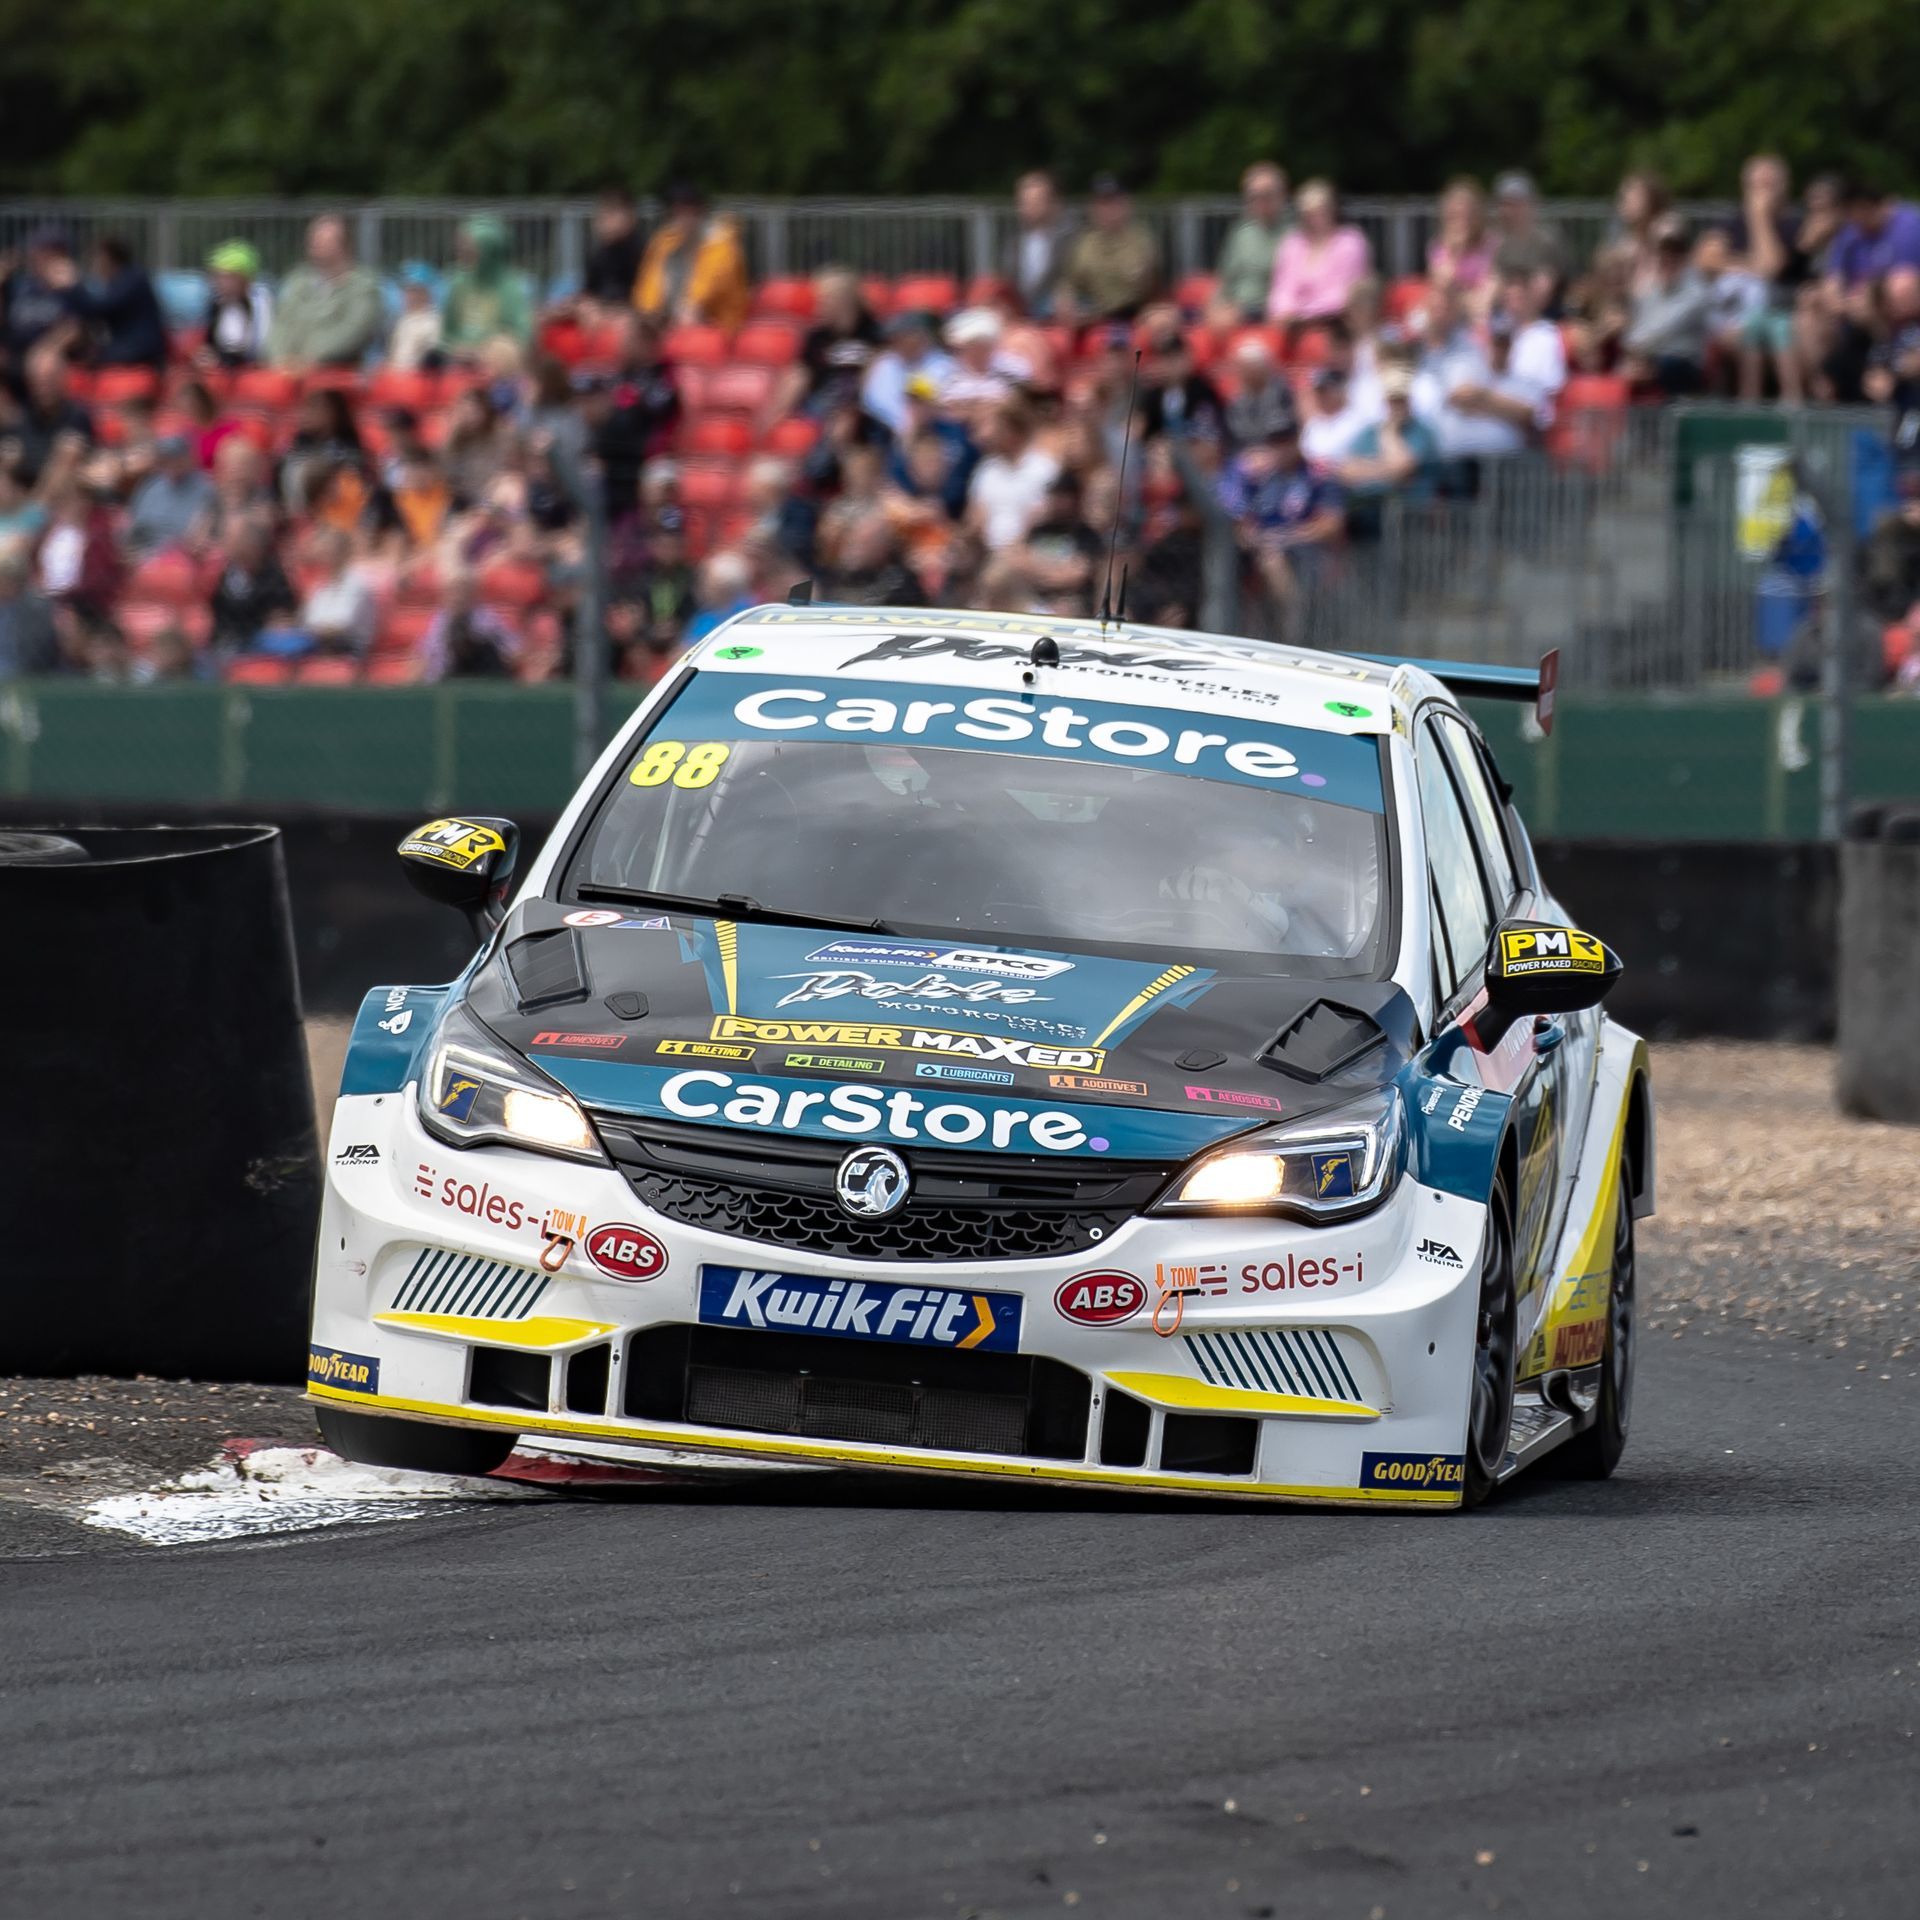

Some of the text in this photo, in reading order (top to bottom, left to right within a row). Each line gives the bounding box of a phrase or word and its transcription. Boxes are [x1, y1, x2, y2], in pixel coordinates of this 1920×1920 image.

[629, 740, 730, 789] 88
[953, 954, 1050, 972] BTCC
[1507, 959, 1602, 974] POWER MAXED RACING
[877, 1000, 1088, 1035] MOTORCYCLES
[560, 1033, 617, 1047] ADHESIVES
[721, 1020, 903, 1045] POWER
[691, 1044, 742, 1058] VALETING
[818, 1058, 874, 1071] DETAILING
[942, 1066, 1010, 1084] LUBRICANTS
[1081, 1079, 1138, 1094] ADDITIVES
[1217, 1092, 1272, 1107] AEROSOLS
[336, 1144, 381, 1159] JFA
[334, 1159, 379, 1167] TUNING
[440, 1174, 552, 1241] sales-i
[552, 1208, 576, 1233] TOW
[594, 1234, 658, 1270] ABS
[1416, 1238, 1464, 1262] JFA
[1416, 1253, 1464, 1269] TUNING
[1170, 1265, 1198, 1288] TOW
[1240, 1252, 1364, 1294] sales-i
[1070, 1282, 1134, 1311] ABS
